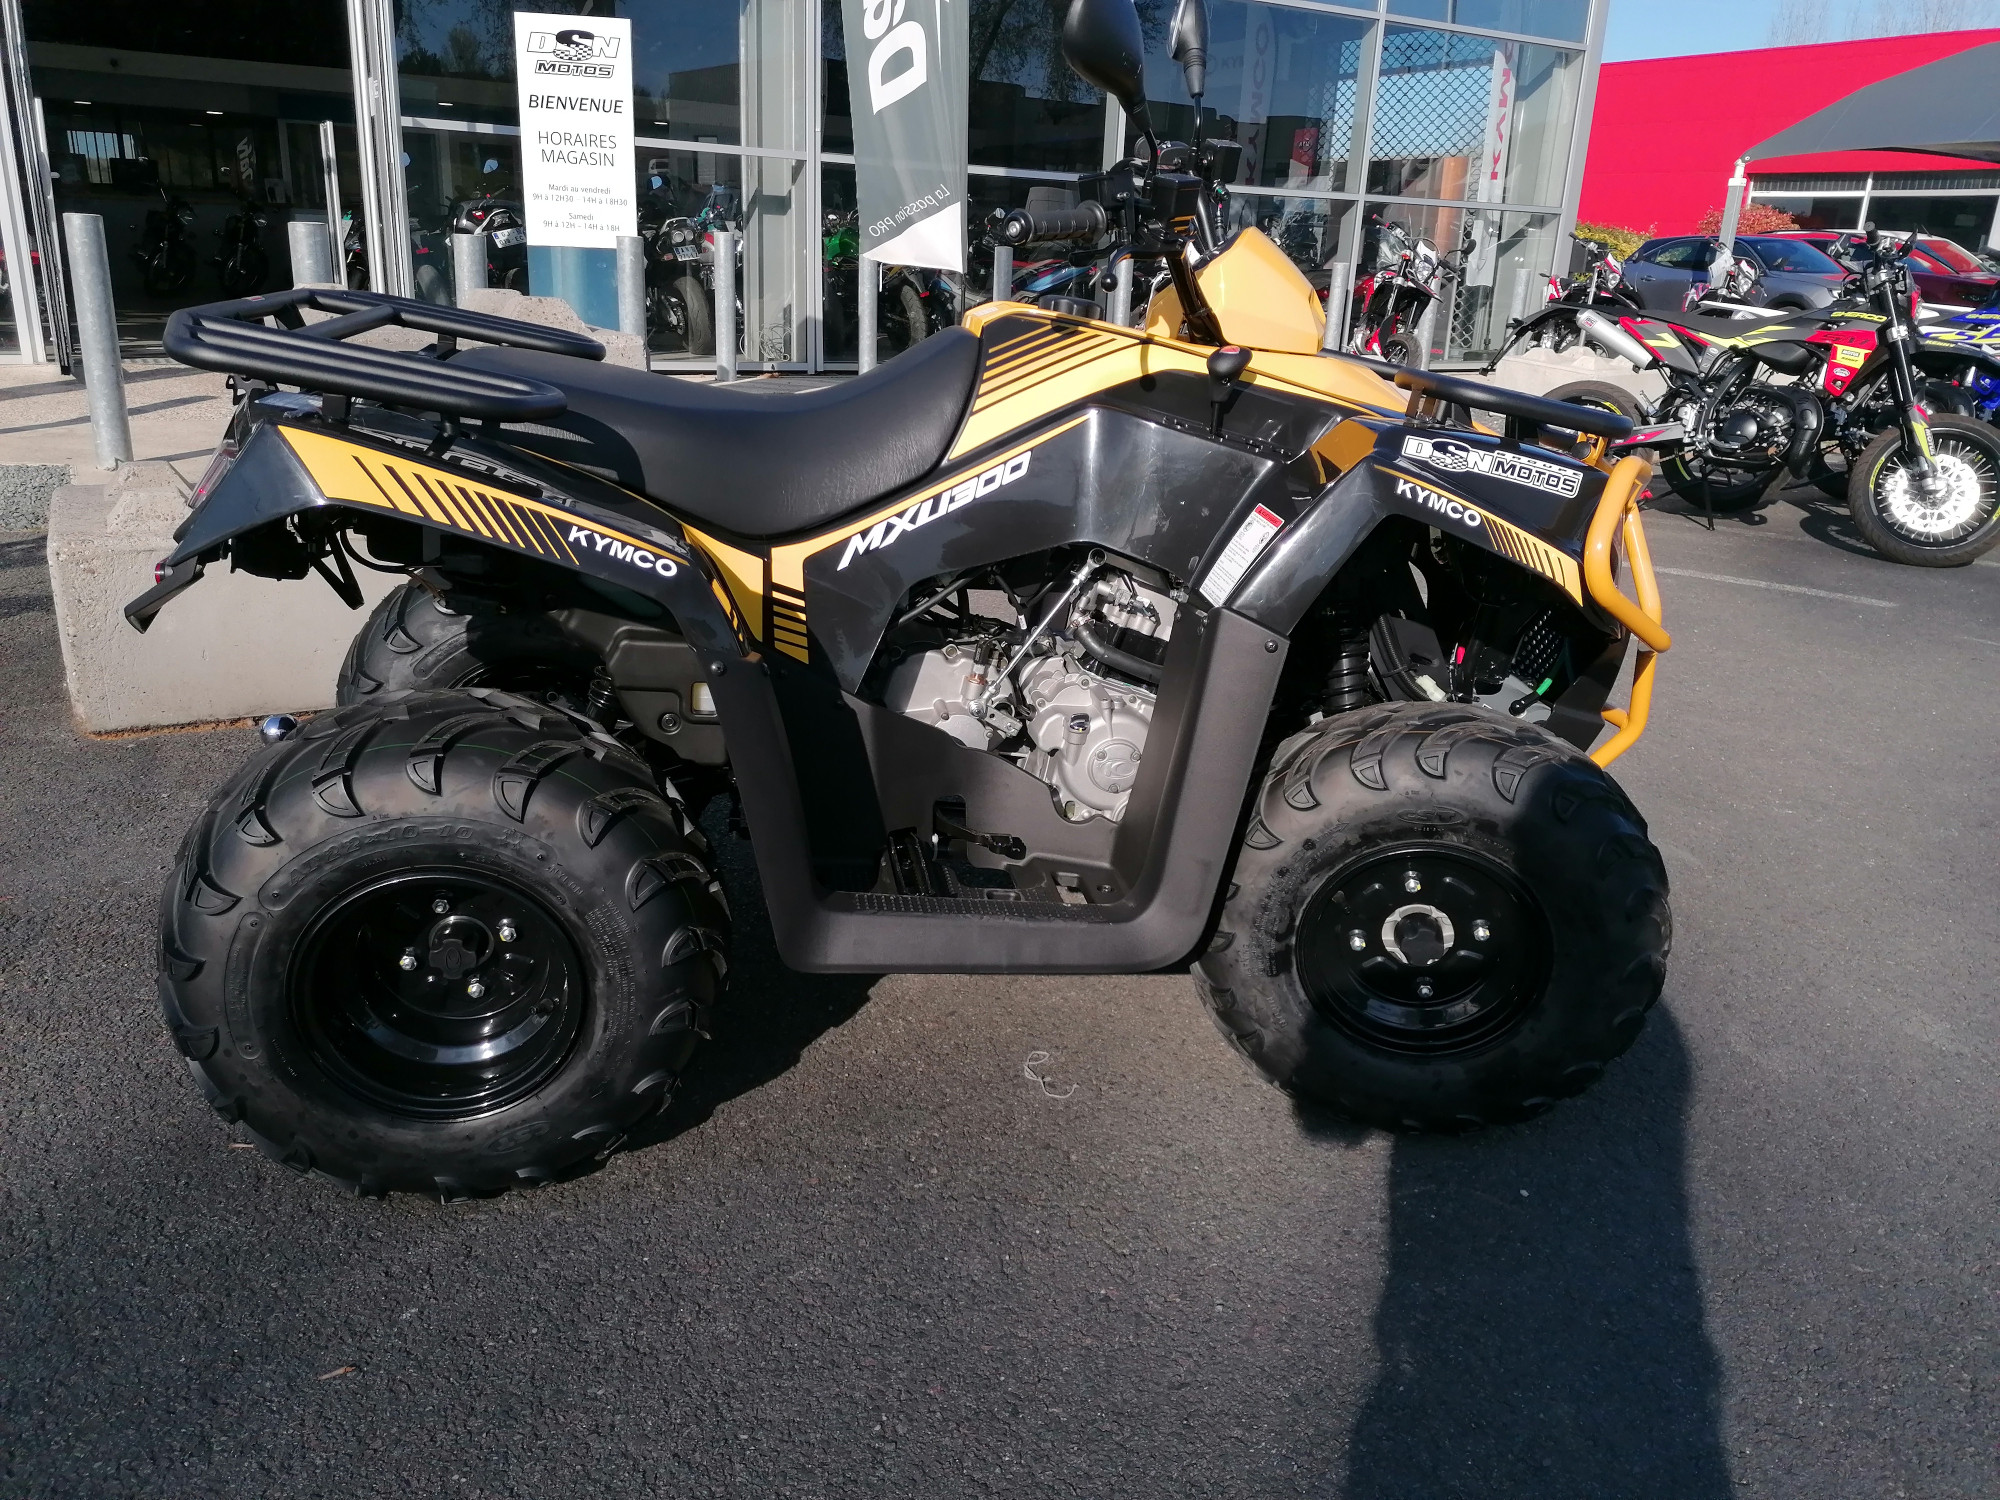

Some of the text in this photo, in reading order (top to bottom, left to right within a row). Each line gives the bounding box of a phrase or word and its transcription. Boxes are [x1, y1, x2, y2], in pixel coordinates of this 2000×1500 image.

[526, 29, 620, 61] DSN
[535, 60, 615, 78] MOTOS
[528, 94, 624, 114] BIENVENUE
[538, 130, 617, 149] HORAIRES
[541, 148, 615, 167] MAGASIN
[548, 183, 569, 192] Mardi
[580, 186, 611, 195] vendredi
[532, 193, 543, 201] 9H
[551, 194, 574, 203] 12H30
[583, 196, 597, 204] 14H
[605, 198, 628, 207] 18H30
[542, 220, 553, 228] 9H
[562, 221, 576, 229] 12H
[584, 222, 598, 231] 14H
[606, 224, 620, 232] 18H
[568, 212, 594, 221] Samedi
[1830, 311, 1888, 323] SHERCO
[1924, 428, 1936, 457] MOTUL
[1402, 435, 1494, 474] DSN
[1493, 457, 1580, 495] MOTOS
[836, 450, 1032, 572] MXU300
[1396, 478, 1482, 527] KYMCO
[567, 525, 678, 577] KYMCO
